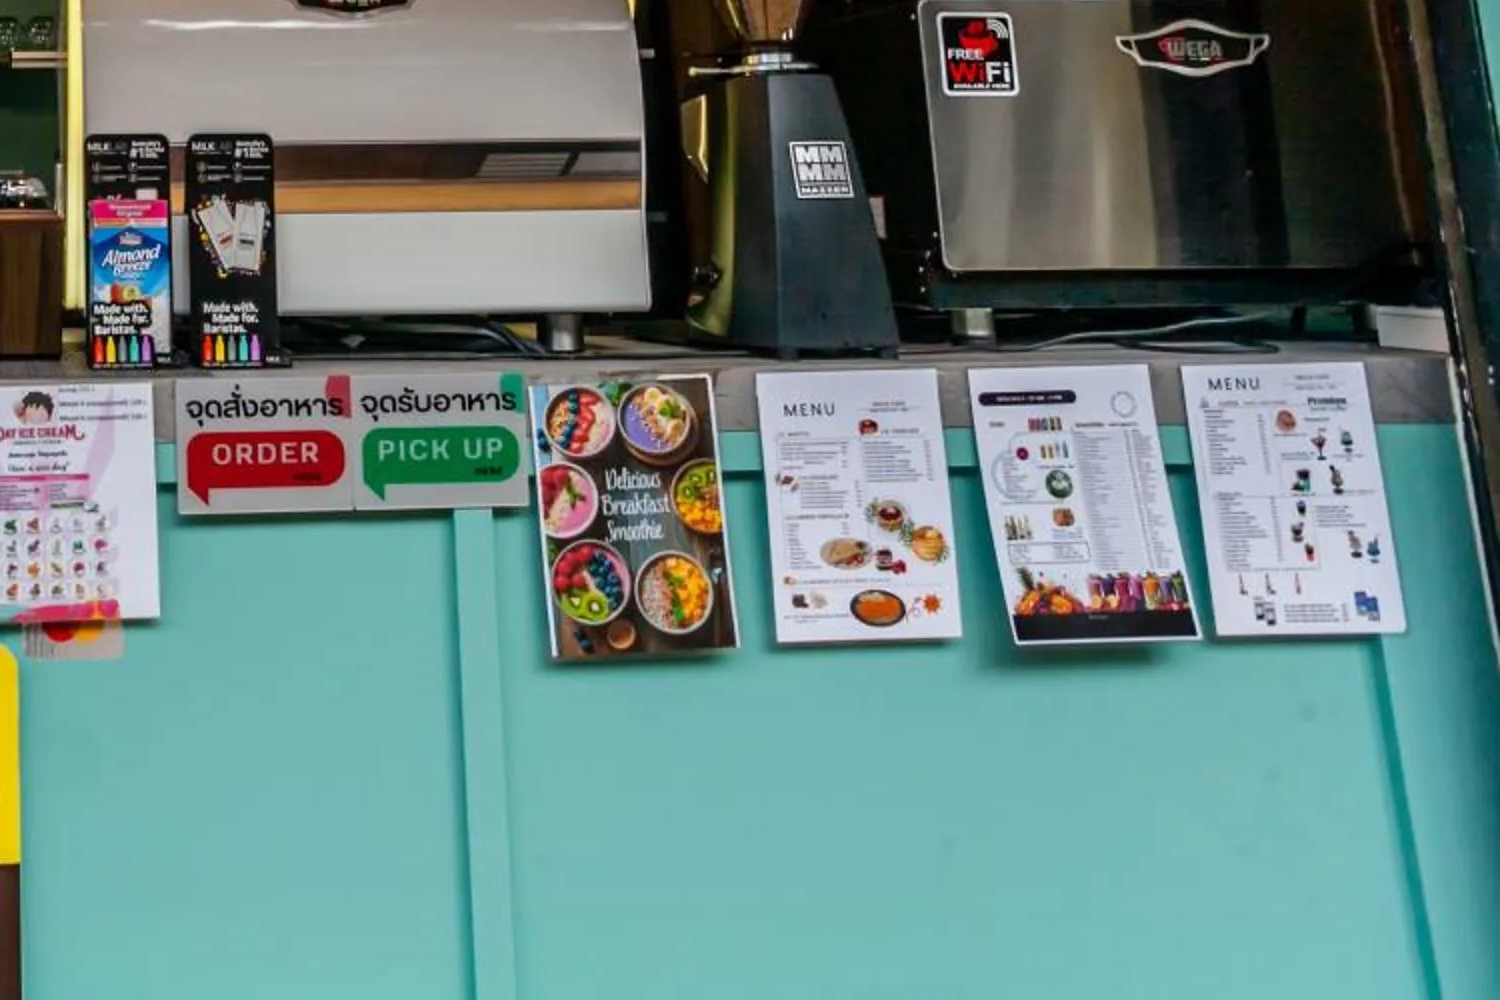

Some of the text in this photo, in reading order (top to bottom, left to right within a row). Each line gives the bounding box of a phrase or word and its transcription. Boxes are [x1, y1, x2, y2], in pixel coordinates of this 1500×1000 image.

[947, 48, 985, 61] FREE
[1167, 37, 1223, 61] WEGA
[949, 61, 1011, 84] WiFi
[102, 243, 161, 267] Almond
[93, 304, 121, 315] Made
[203, 302, 230, 313] Made
[212, 313, 239, 323] Made
[103, 314, 130, 325] Made
[1208, 376, 1261, 391] MENU
[186, 384, 344, 427] จุดสั่งอาหาร
[360, 387, 517, 423] จุดรับอาหาร
[783, 402, 836, 418] MENU
[37, 424, 85, 441] CREAM
[211, 441, 320, 466] ORDER
[378, 437, 504, 462] PICK UP
[605, 467, 662, 491] Delicious
[601, 492, 671, 517] Breakfast
[605, 518, 665, 543] Smoothie
